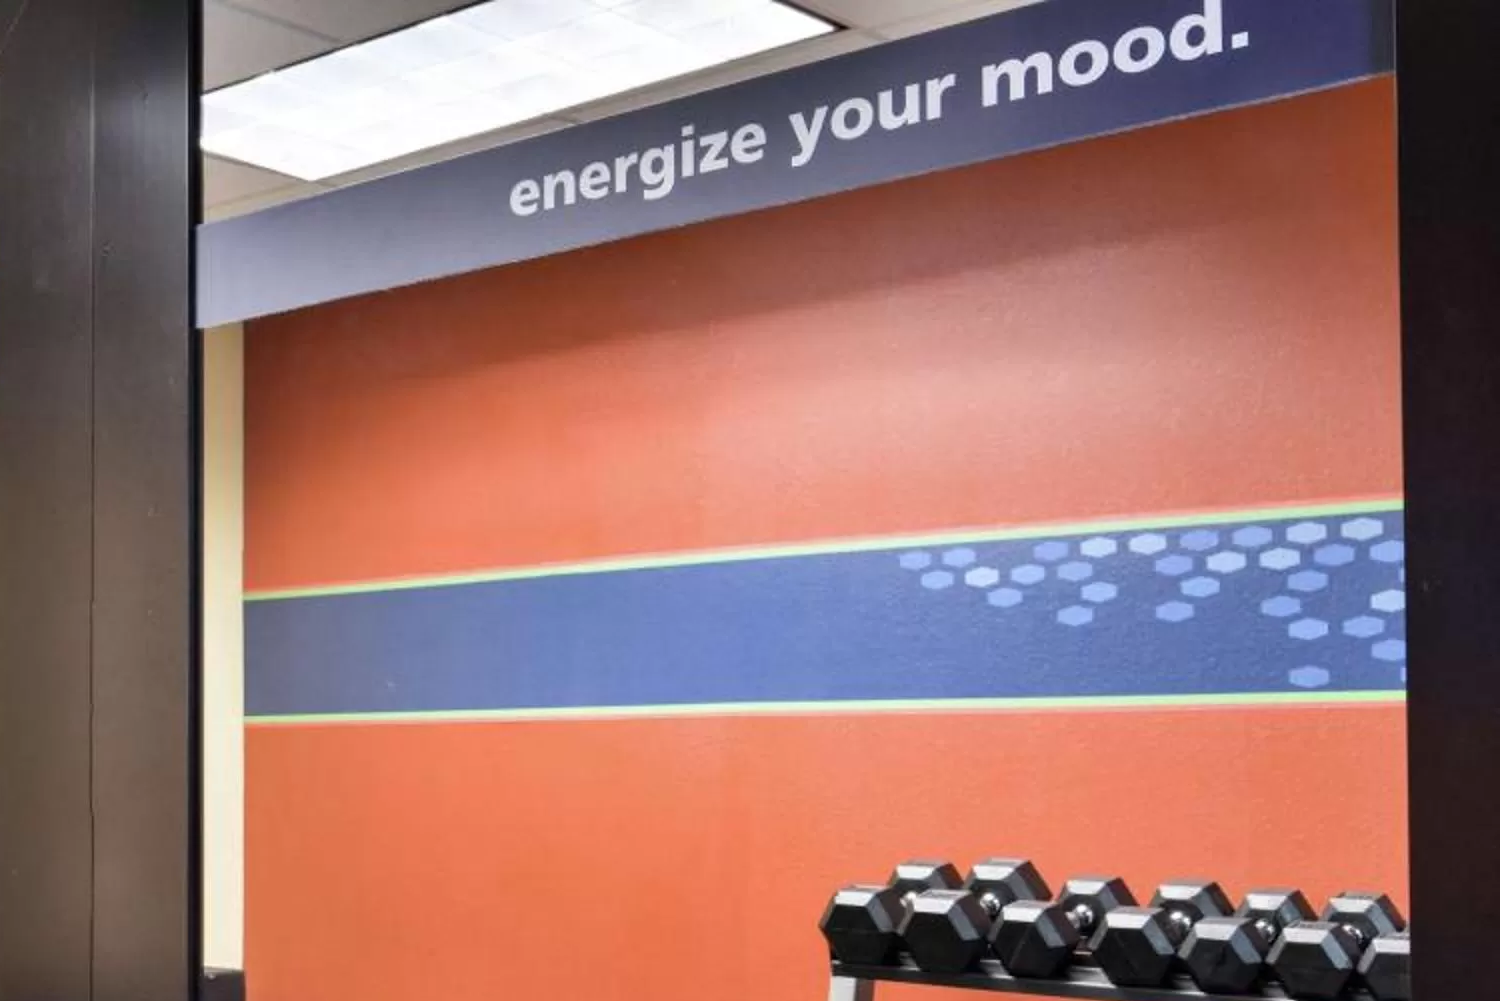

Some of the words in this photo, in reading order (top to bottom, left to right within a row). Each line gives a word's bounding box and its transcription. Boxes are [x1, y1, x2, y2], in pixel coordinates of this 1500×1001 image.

[509, 123, 768, 217] energize
[790, 74, 956, 167] your
[981, 0, 1249, 107] mood.
